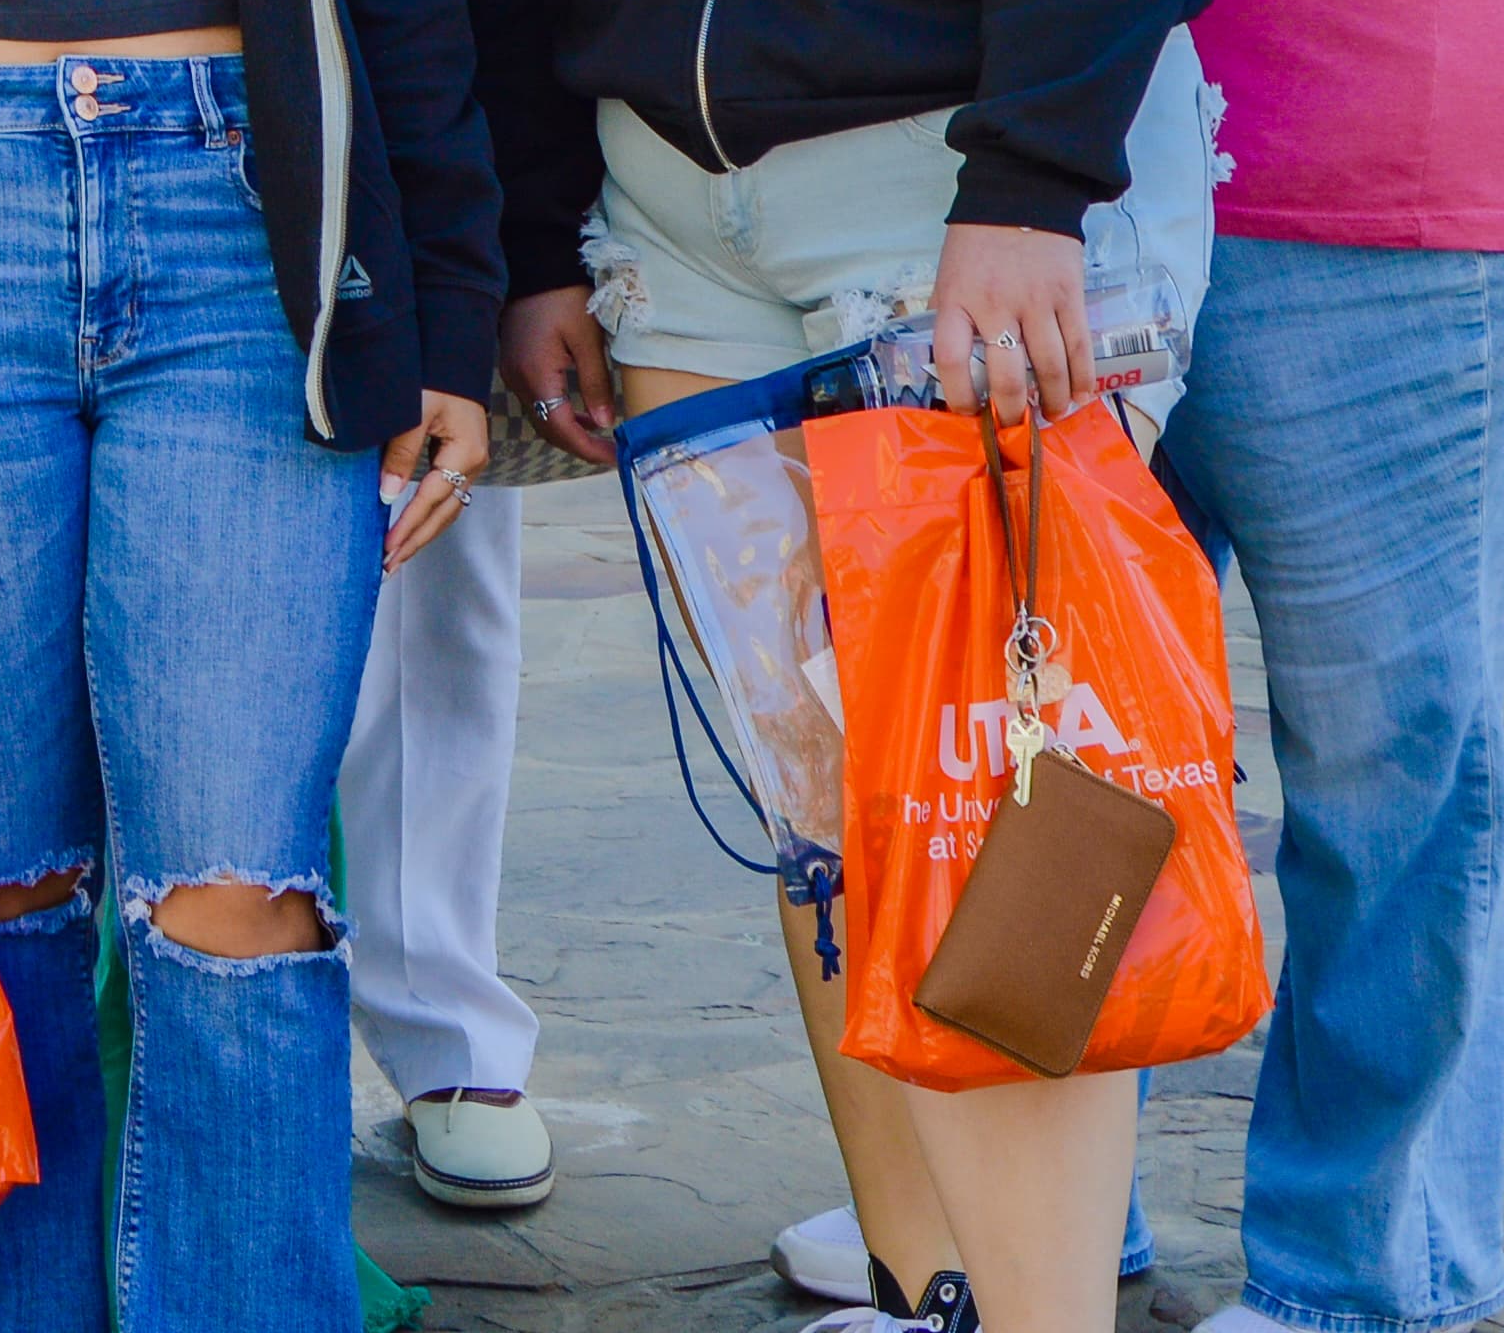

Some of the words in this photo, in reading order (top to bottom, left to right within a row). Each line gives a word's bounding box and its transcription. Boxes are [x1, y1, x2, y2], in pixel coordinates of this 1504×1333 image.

[1122, 759, 1218, 797] Texas
[903, 794, 932, 824] he
[928, 834, 957, 861] at
